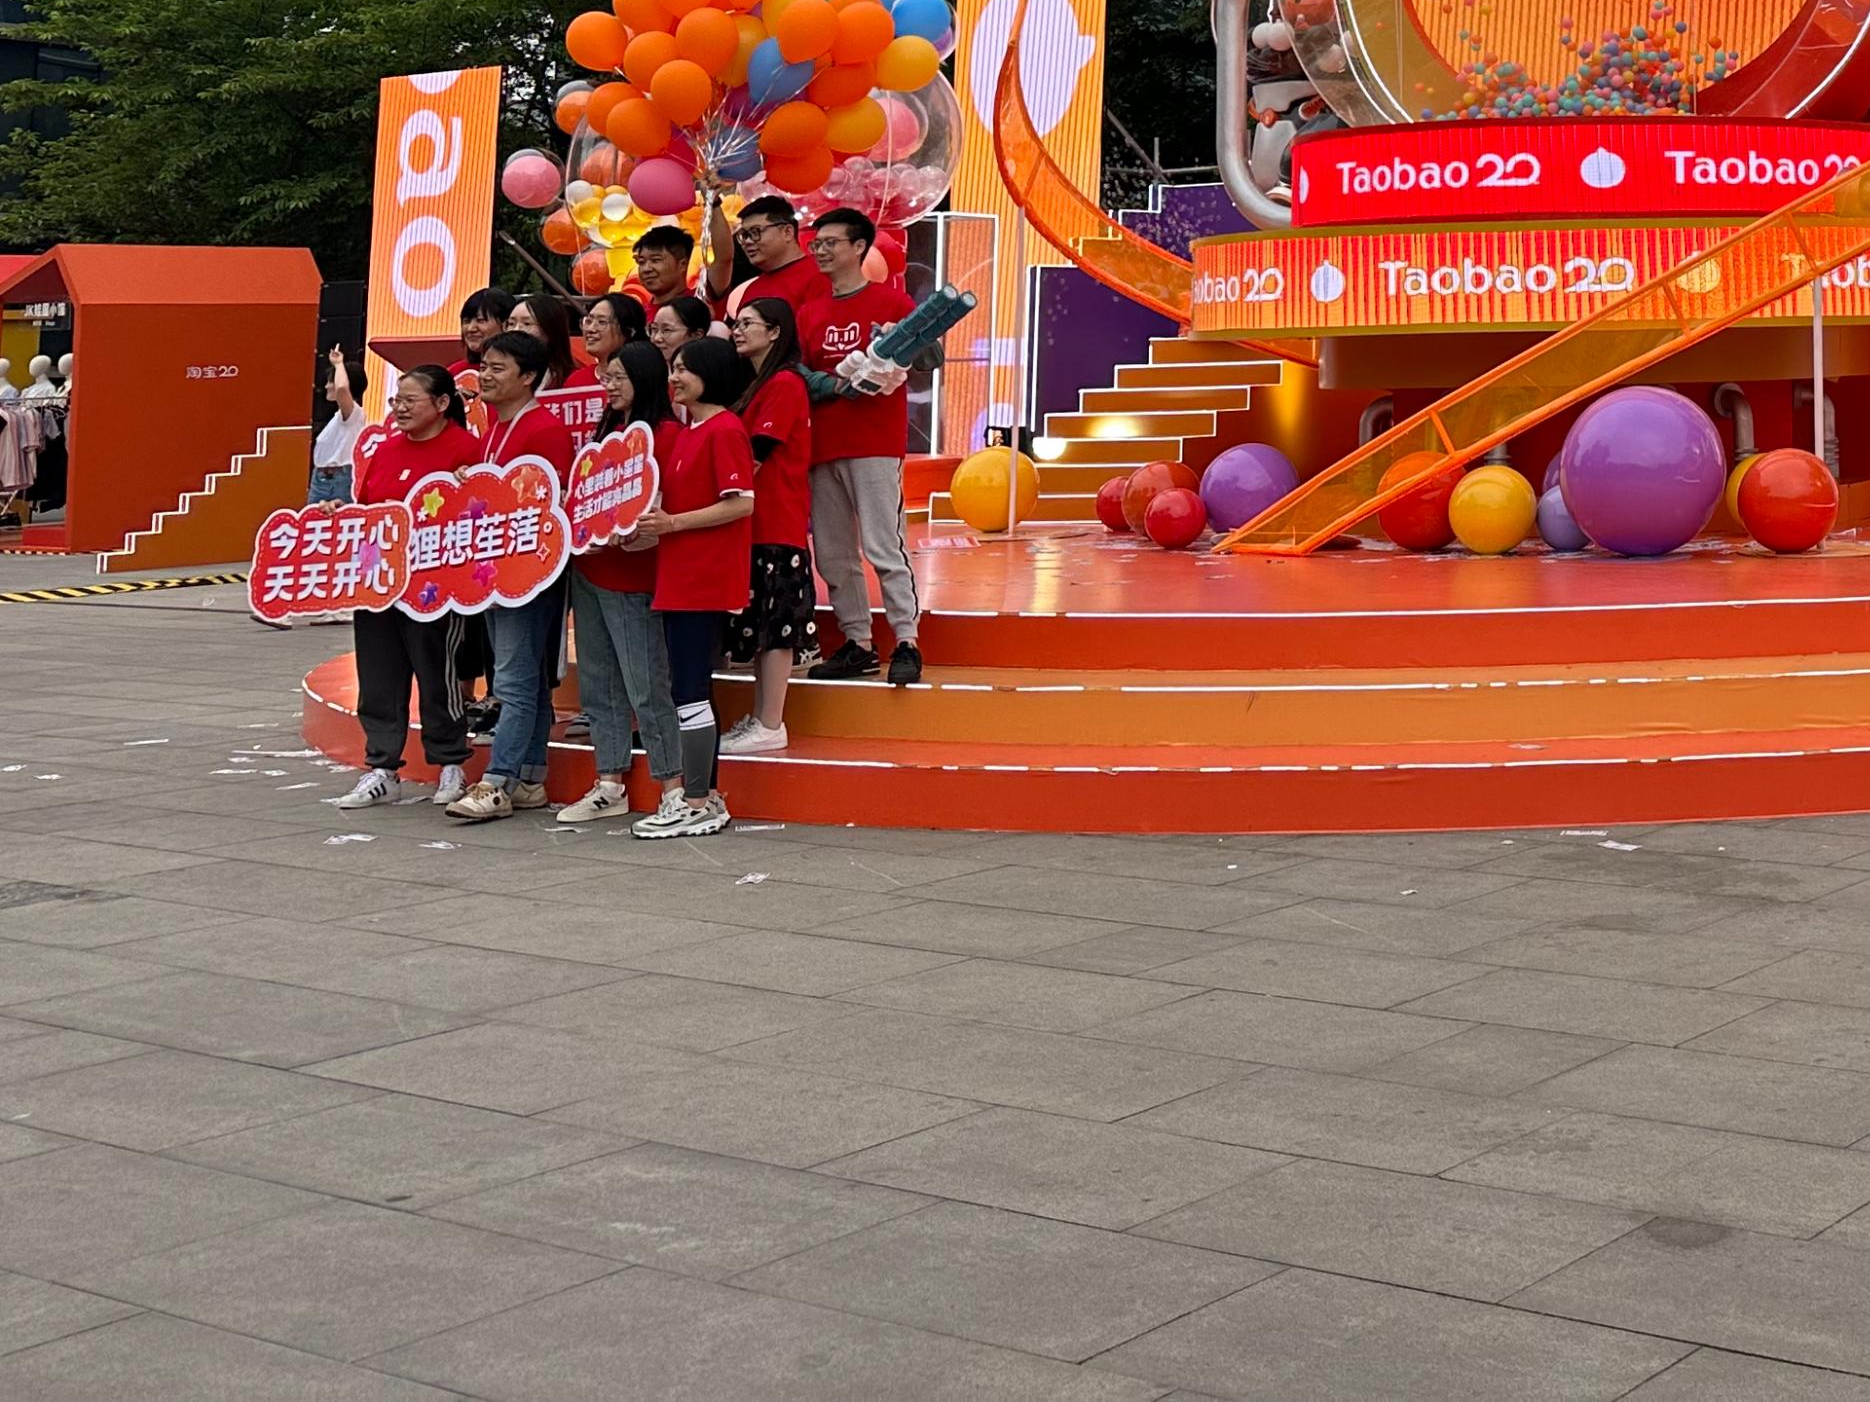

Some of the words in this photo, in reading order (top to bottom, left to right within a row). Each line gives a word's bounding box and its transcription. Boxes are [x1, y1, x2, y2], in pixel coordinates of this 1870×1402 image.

[1335, 156, 1470, 195] Taobao
[1663, 150, 1820, 186] Taobao
[392, 71, 462, 318] ao
[1192, 270, 1241, 305] obao
[1242, 267, 1285, 302] 20
[1378, 257, 1558, 297] Taobao
[1563, 256, 1636, 293] 20
[269, 514, 399, 560] 今天开心
[262, 558, 396, 603] 天天开心
